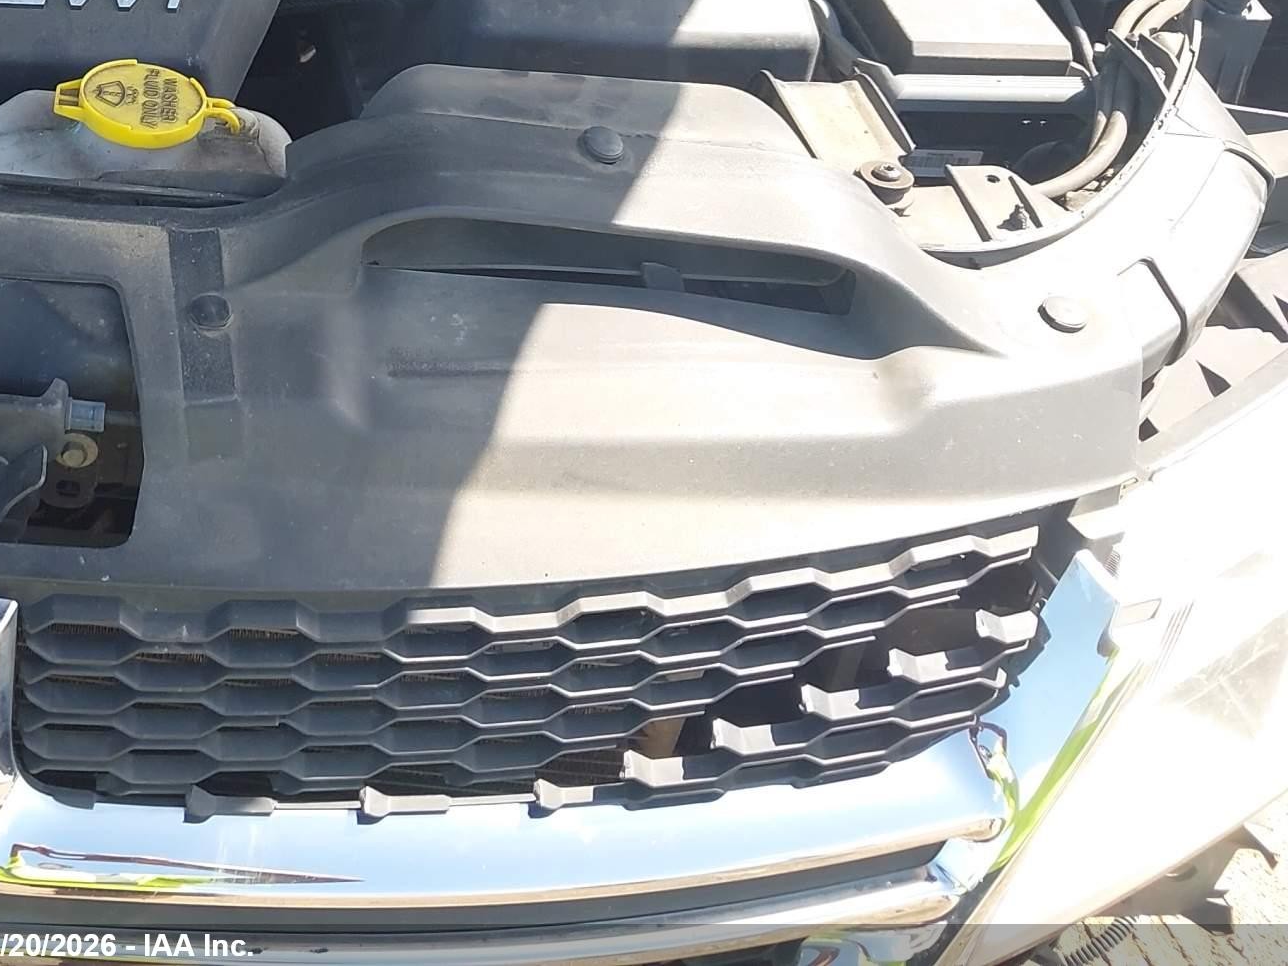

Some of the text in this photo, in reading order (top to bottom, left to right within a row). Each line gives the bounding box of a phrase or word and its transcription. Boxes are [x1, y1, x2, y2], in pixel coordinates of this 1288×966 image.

[140, 68, 160, 129] FLUID ONLY
[160, 77, 178, 123] WASHER
